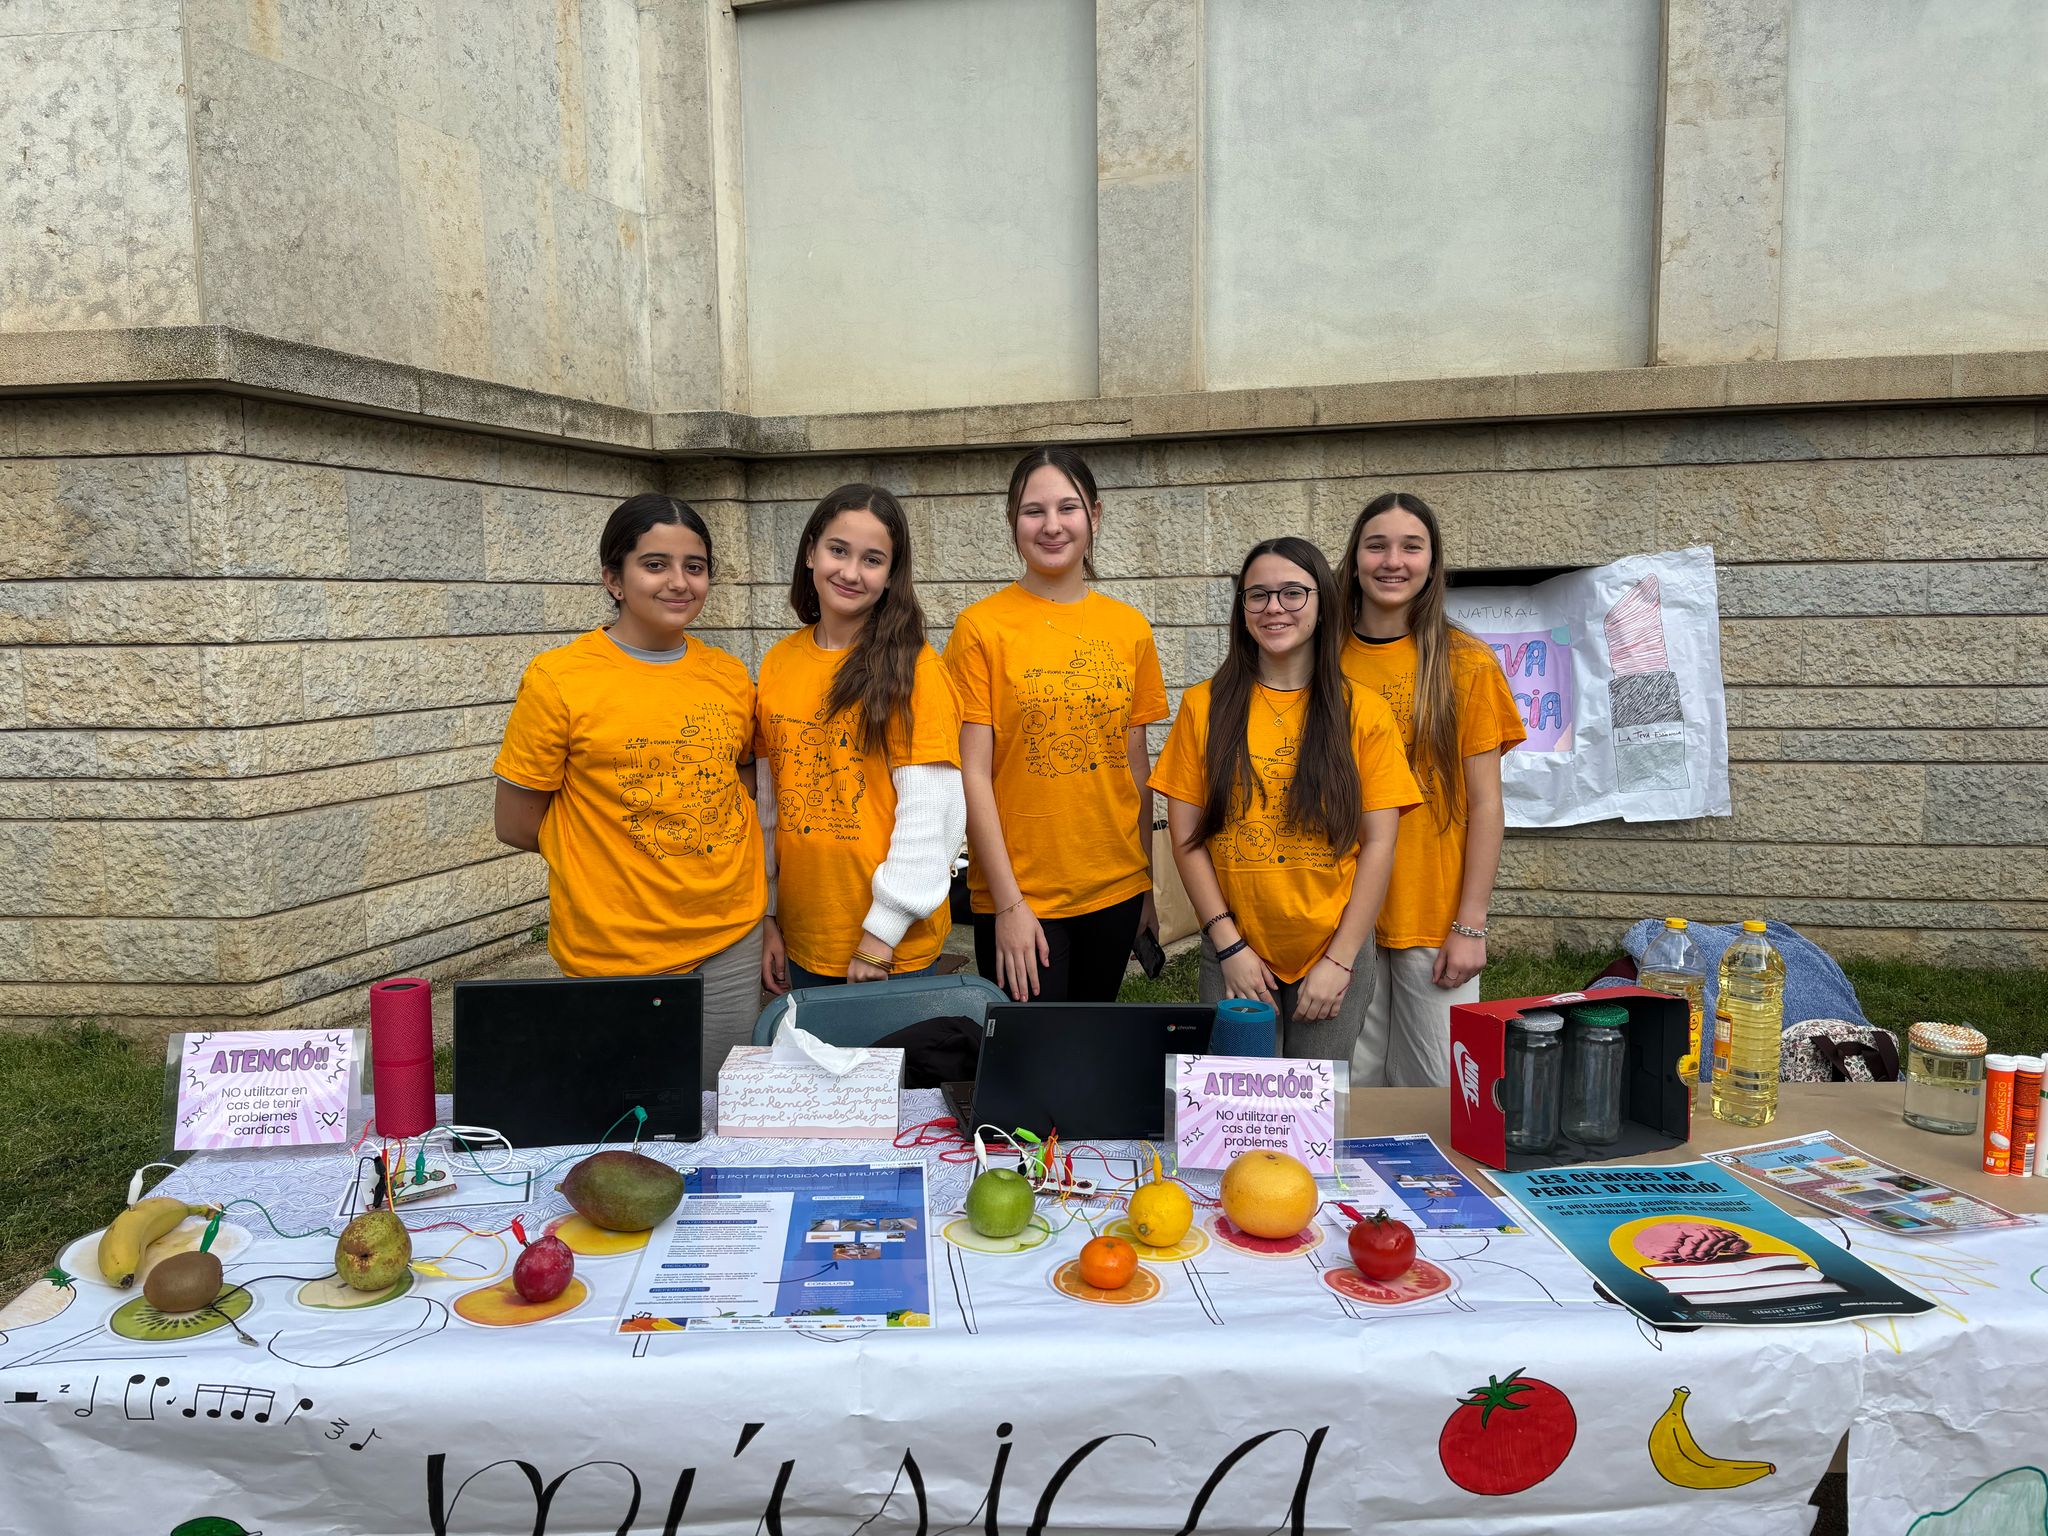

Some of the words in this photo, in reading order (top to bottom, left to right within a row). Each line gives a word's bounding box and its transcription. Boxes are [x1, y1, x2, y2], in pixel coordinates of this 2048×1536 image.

[1457, 606, 1539, 619] NATURAL
[210, 1040, 330, 1074] ATENCIÓ!!
[1204, 1068, 1314, 1099] ATENCIÓ!!
[1464, 1053, 1480, 1109] NIKE
[222, 1087, 242, 1098] NO
[244, 1086, 289, 1097] utilitzar
[292, 1086, 308, 1096] en
[226, 1100, 250, 1111] cas
[252, 1098, 270, 1110] de
[272, 1098, 302, 1109] tenir
[1996, 1082, 2008, 1130] MAGNESIO
[228, 1111, 298, 1126] problemes
[1216, 1110, 1234, 1120] NO
[1236, 1112, 1278, 1122] utilitzar
[1282, 1114, 1296, 1123] en
[234, 1124, 290, 1136] cardíacs
[1222, 1125, 1243, 1134] cas
[1246, 1124, 1262, 1134] de
[1264, 1125, 1290, 1136] tenir
[1224, 1136, 1288, 1148] problemes
[1526, 1174, 1568, 1185] LES
[1568, 1171, 1662, 1183] CIÈNCIES
[1662, 1171, 1696, 1181] EN
[1526, 1184, 1602, 1198] PERILL
[1602, 1180, 1728, 1194] D'EXTINCIÓ!
[1590, 1200, 1636, 1210] formació
[1596, 1206, 1640, 1215] baixada
[1642, 1206, 1682, 1214] d'hores
